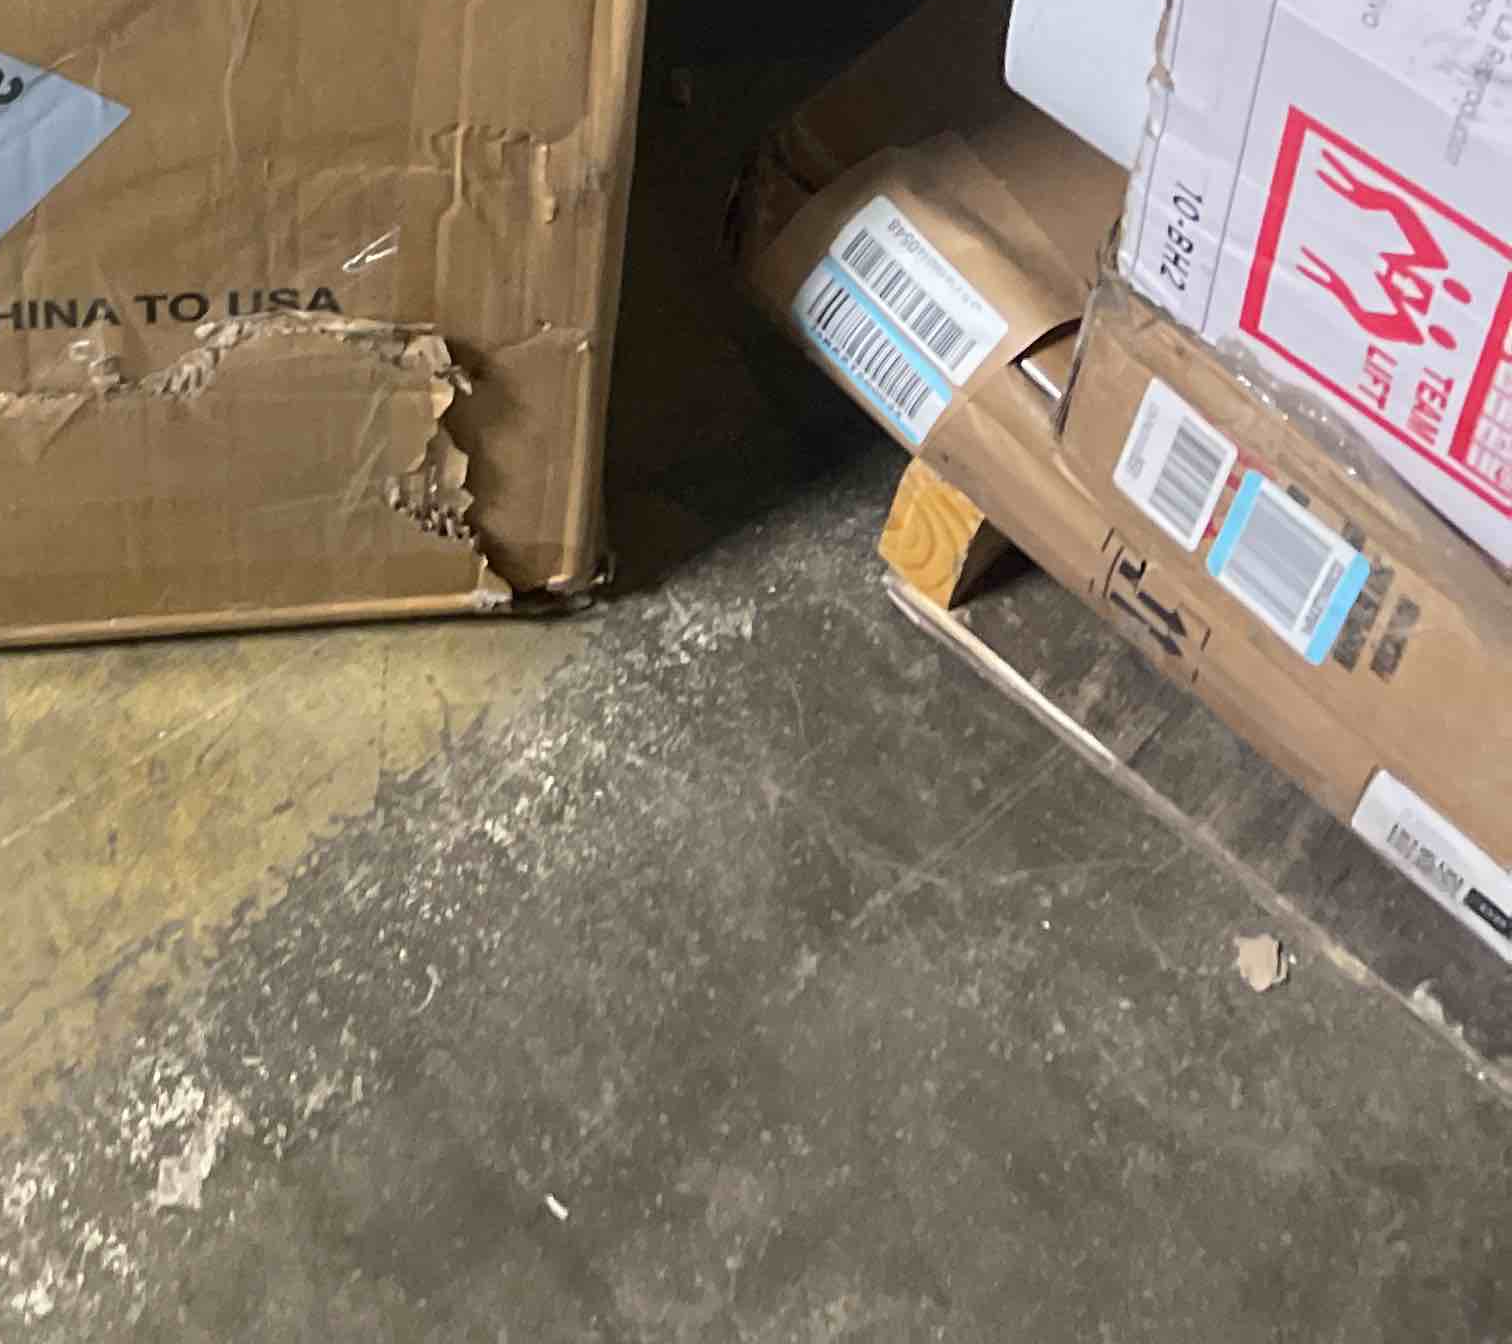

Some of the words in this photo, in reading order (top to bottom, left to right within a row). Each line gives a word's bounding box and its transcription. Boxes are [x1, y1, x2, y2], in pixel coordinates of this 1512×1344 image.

[134, 291, 210, 325] TO
[226, 286, 344, 317] USA
[1357, 343, 1399, 411] LIFT
[1403, 367, 1456, 447] TEAM
